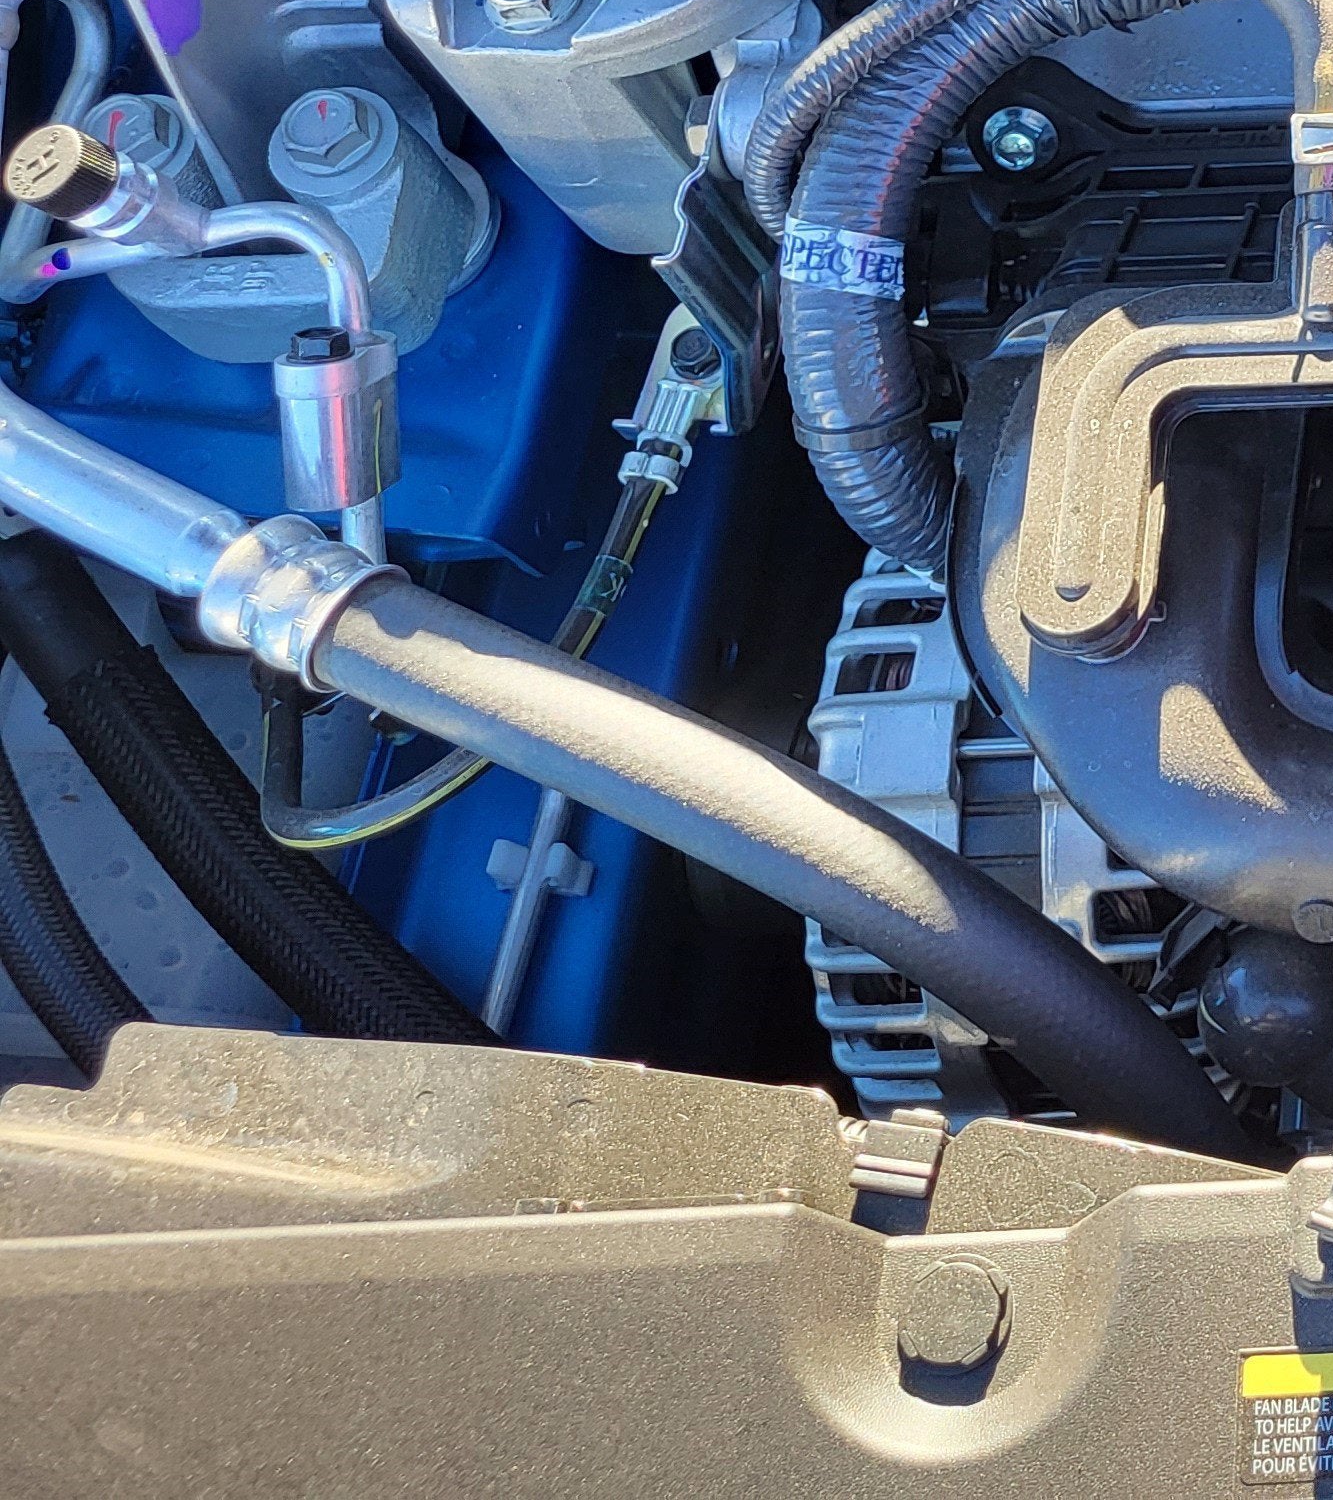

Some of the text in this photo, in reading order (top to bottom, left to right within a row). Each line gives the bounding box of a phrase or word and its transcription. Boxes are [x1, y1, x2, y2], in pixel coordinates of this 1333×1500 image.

[1255, 1399, 1281, 1415] FAN
[1284, 1396, 1329, 1414] BLADE
[1255, 1419, 1274, 1435] TO
[1276, 1417, 1311, 1434] HELP
[1253, 1439, 1270, 1455] LE
[1252, 1456, 1295, 1474] POUR
